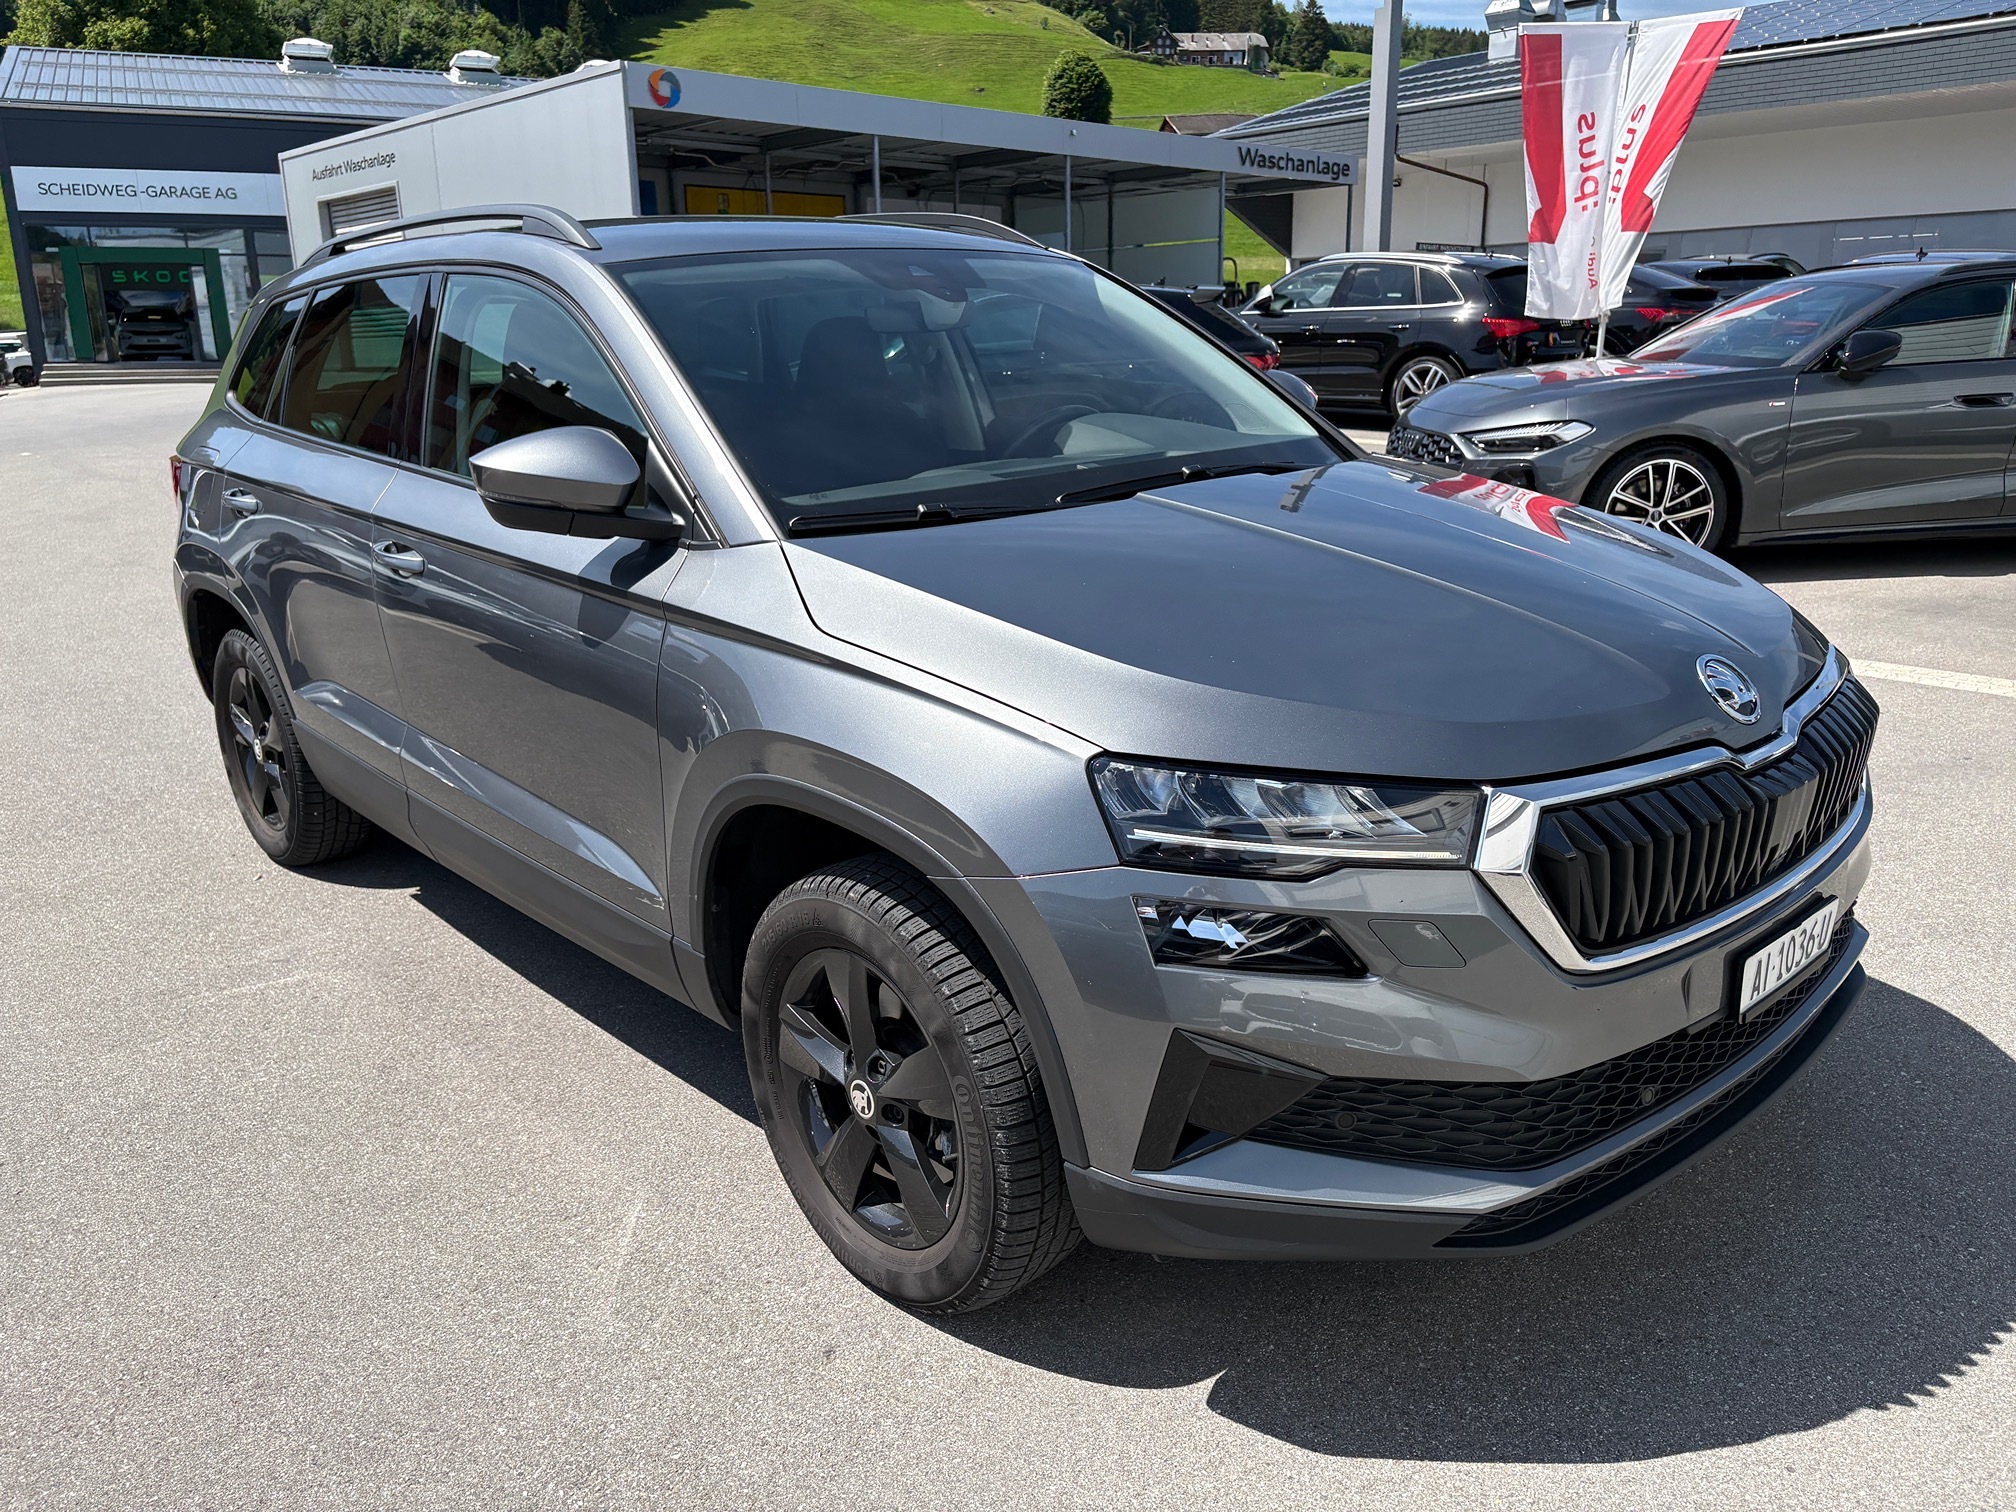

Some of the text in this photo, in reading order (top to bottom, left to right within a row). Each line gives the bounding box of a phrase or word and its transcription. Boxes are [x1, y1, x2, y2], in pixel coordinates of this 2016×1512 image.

[312, 152, 397, 181] Ausfahrt Waschanlage
[1238, 146, 1351, 181] Waschanlage
[214, 187, 238, 200] AG
